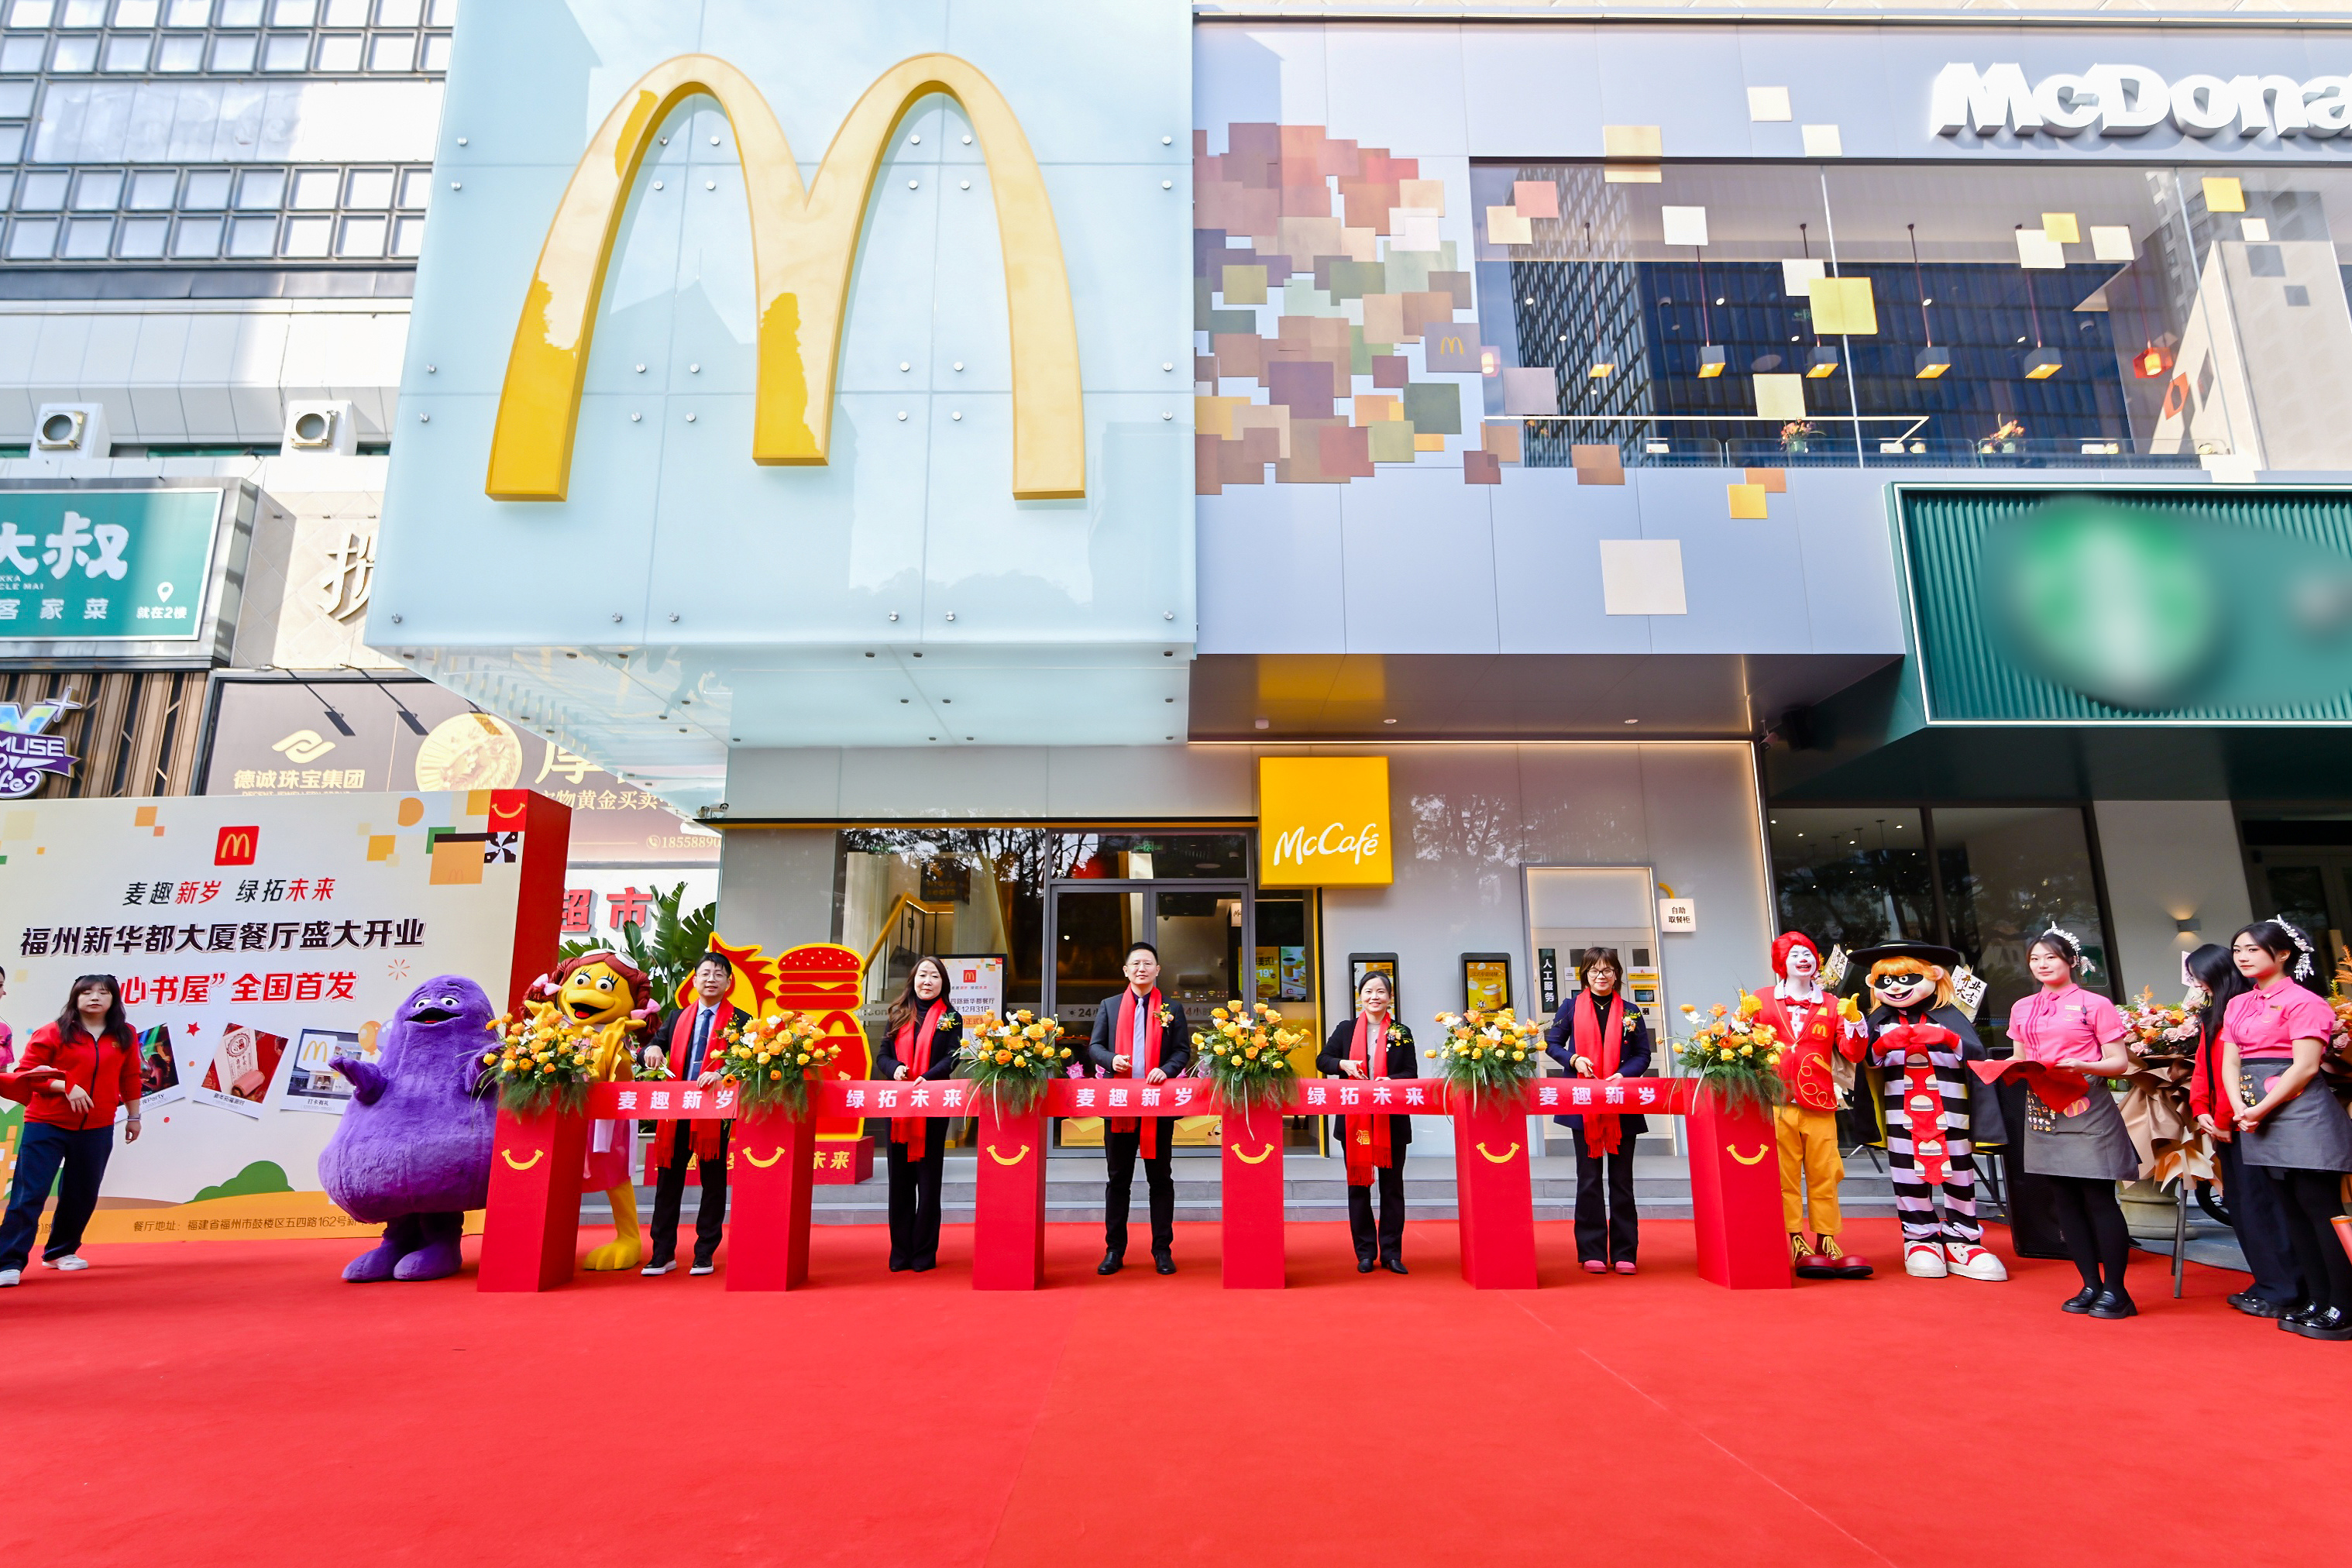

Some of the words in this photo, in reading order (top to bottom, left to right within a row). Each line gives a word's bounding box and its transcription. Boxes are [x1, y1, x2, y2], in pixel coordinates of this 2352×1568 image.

[0, 511, 129, 581] 大叔
[233, 769, 366, 789] 德诚珠宝集团
[1273, 822, 1379, 866] McCafé
[122, 880, 222, 906] 麦趣新岁
[236, 877, 336, 903] 绿拓未来
[1668, 916, 1691, 924] 取餐柜
[1671, 906, 1686, 915] 自助
[20, 918, 425, 957] 福州新华都大厦餐厅盛大开业
[1542, 958, 1555, 1002] 人工服务
[617, 1090, 734, 1110] 麦趣新岁
[846, 1088, 962, 1109] 绿拓未来
[1076, 1088, 1193, 1107] 麦趣新岁
[1307, 1086, 1425, 1106] 绿拓未来
[1539, 1086, 1656, 1106] 麦趣新岁
